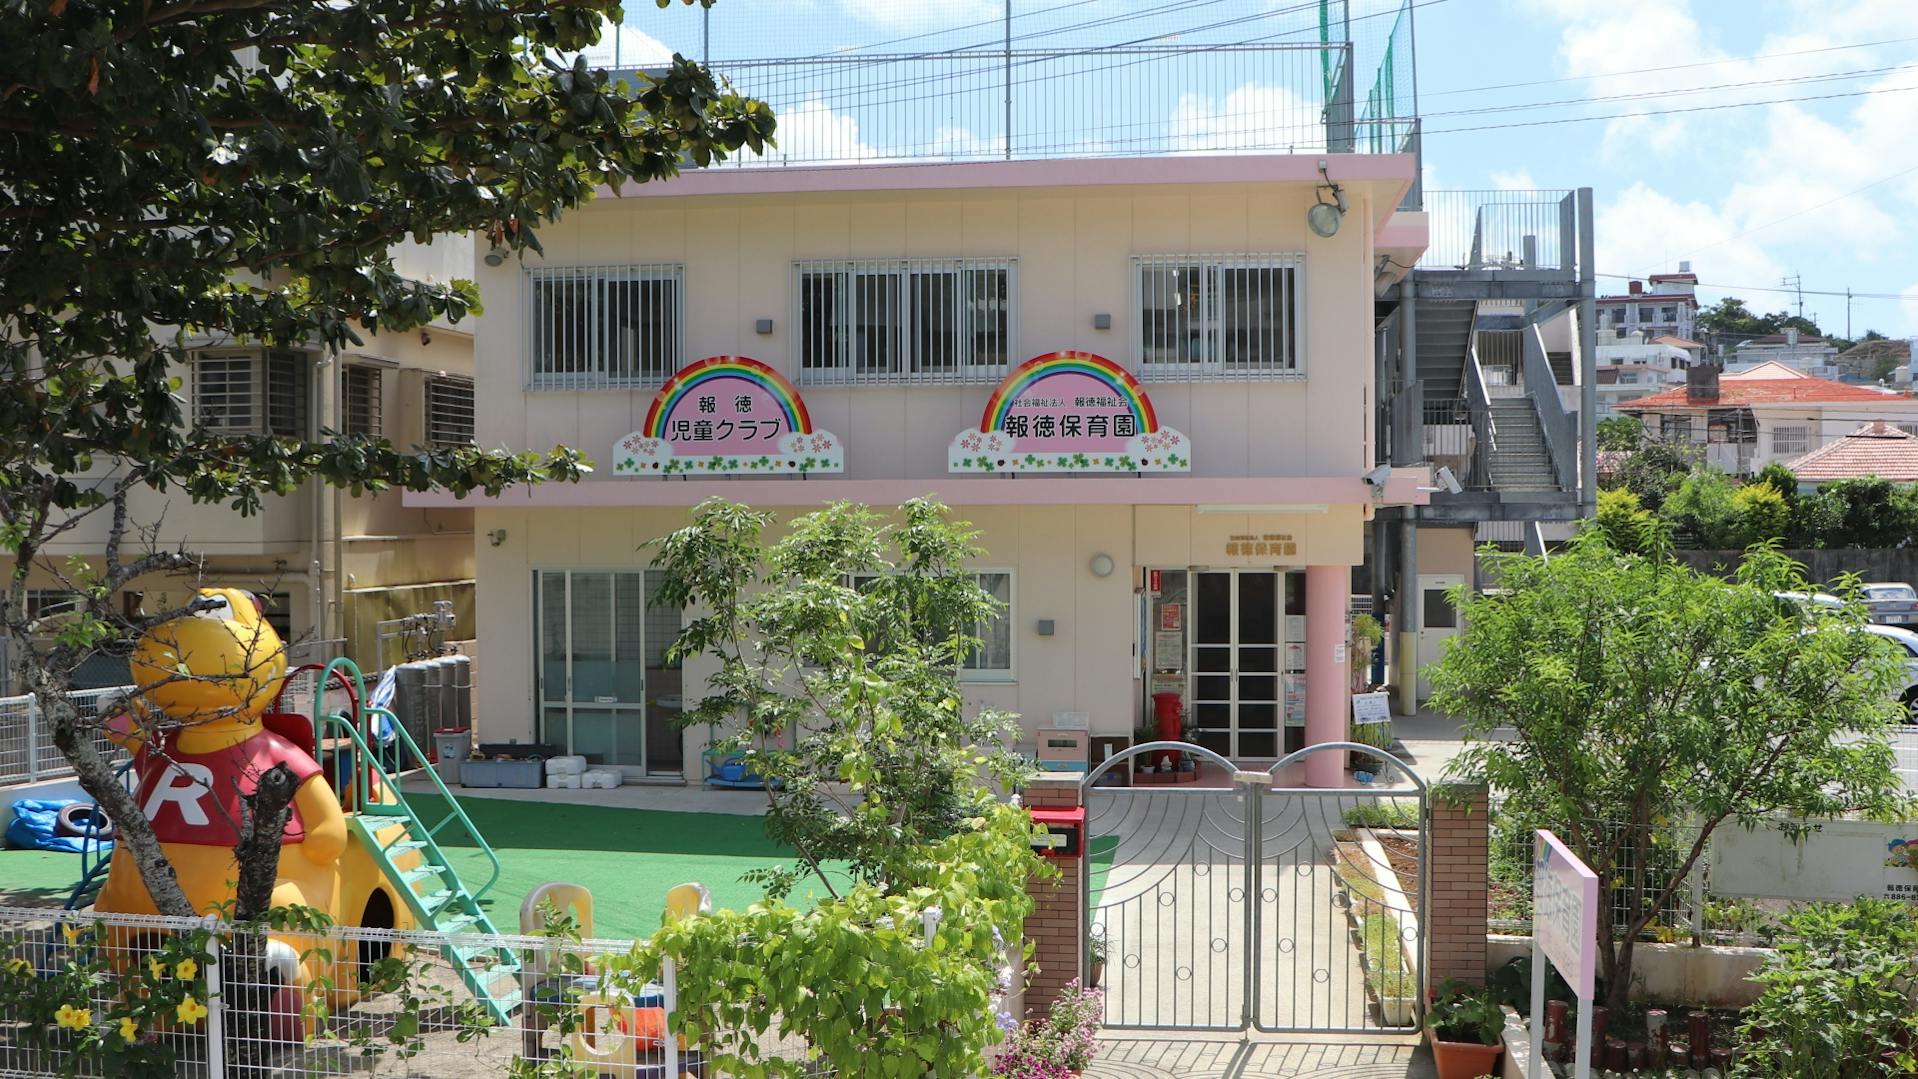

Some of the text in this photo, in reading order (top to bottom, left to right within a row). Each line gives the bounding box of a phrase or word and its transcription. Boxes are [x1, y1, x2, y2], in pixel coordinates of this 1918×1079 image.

[1014, 396, 1128, 408] 社会福祉法人 報徳福祉会
[670, 417, 782, 442] 児童クラブ
[1005, 414, 1136, 438] 報徳保育園
[142, 762, 214, 826] R
